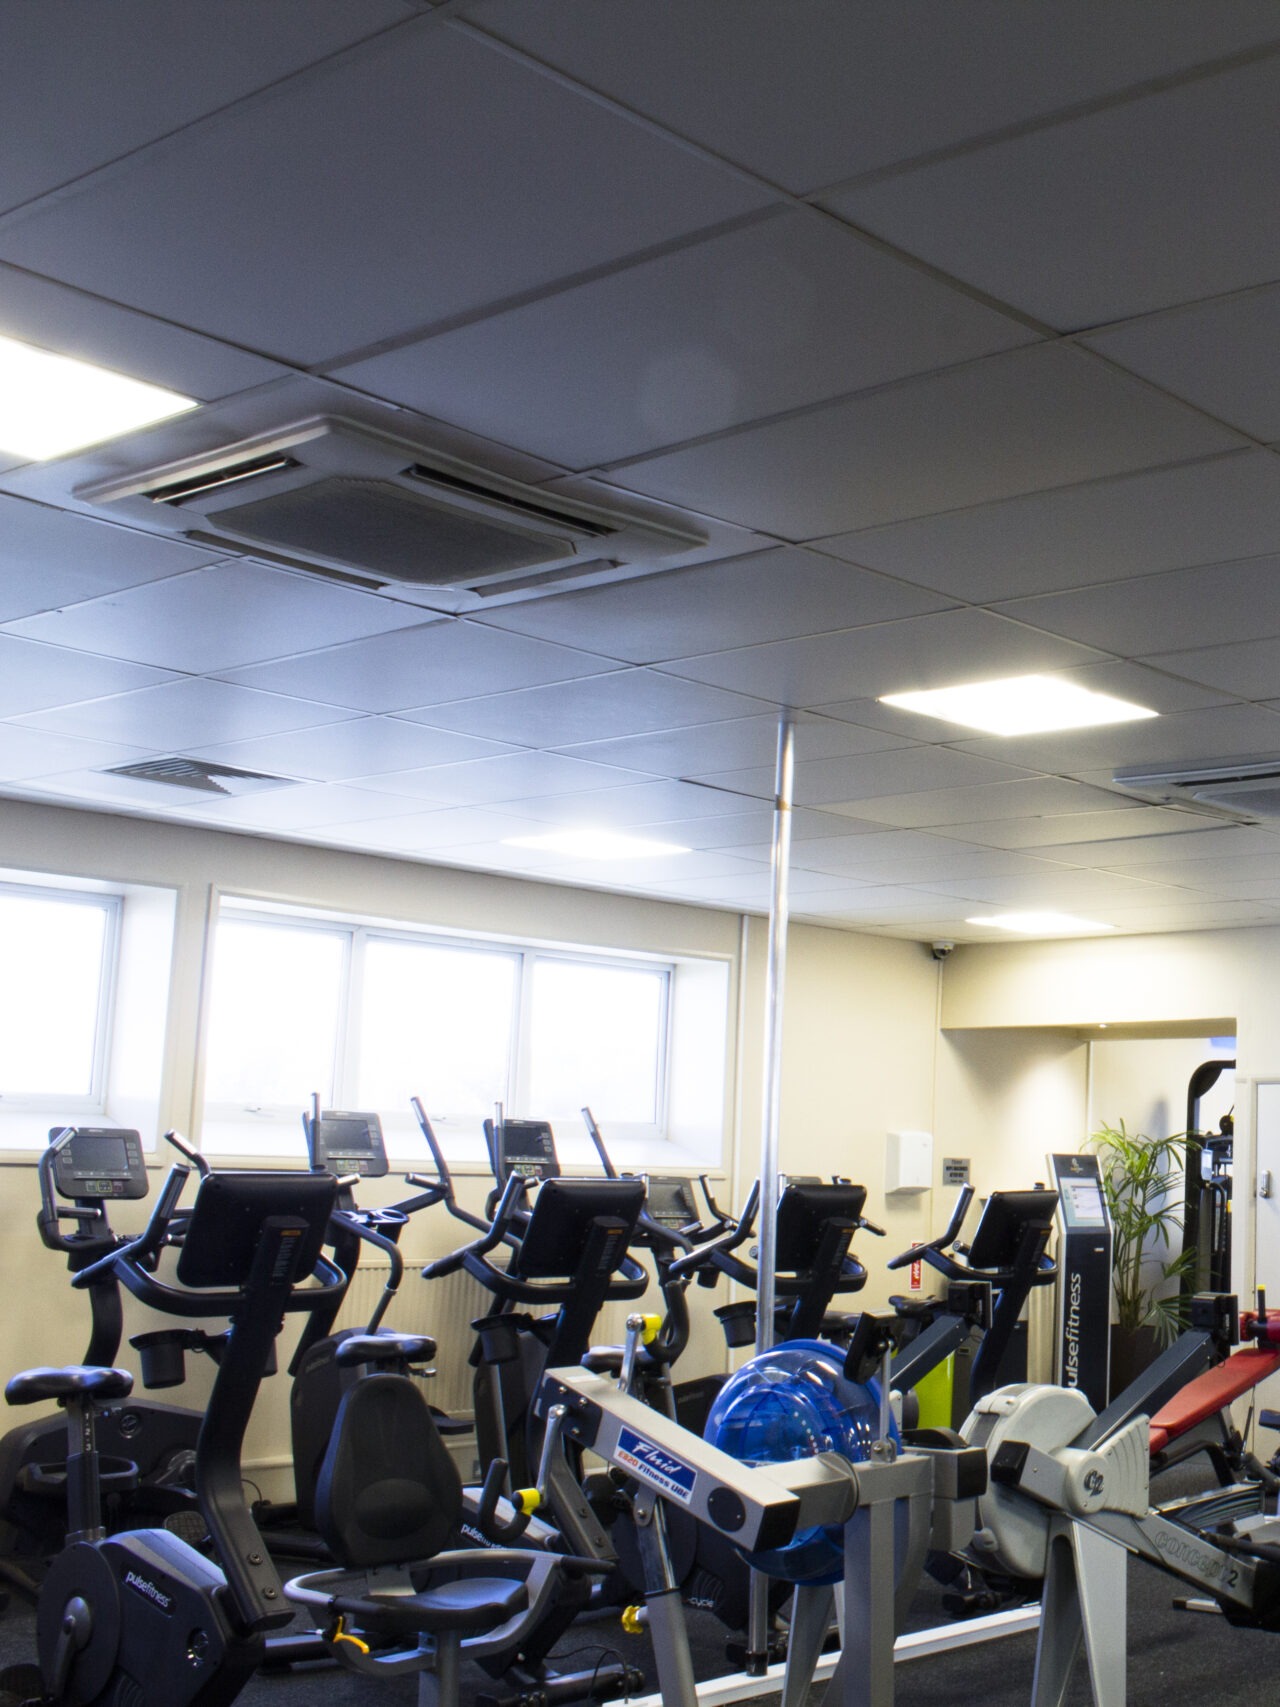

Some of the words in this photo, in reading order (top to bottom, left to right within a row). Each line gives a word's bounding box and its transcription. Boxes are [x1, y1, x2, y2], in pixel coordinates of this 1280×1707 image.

[1065, 1272, 1082, 1388] ulsefitness
[631, 1441, 682, 1474] Fluid
[638, 1463, 669, 1487] Fitness
[125, 1571, 171, 1607] pulsefitness
